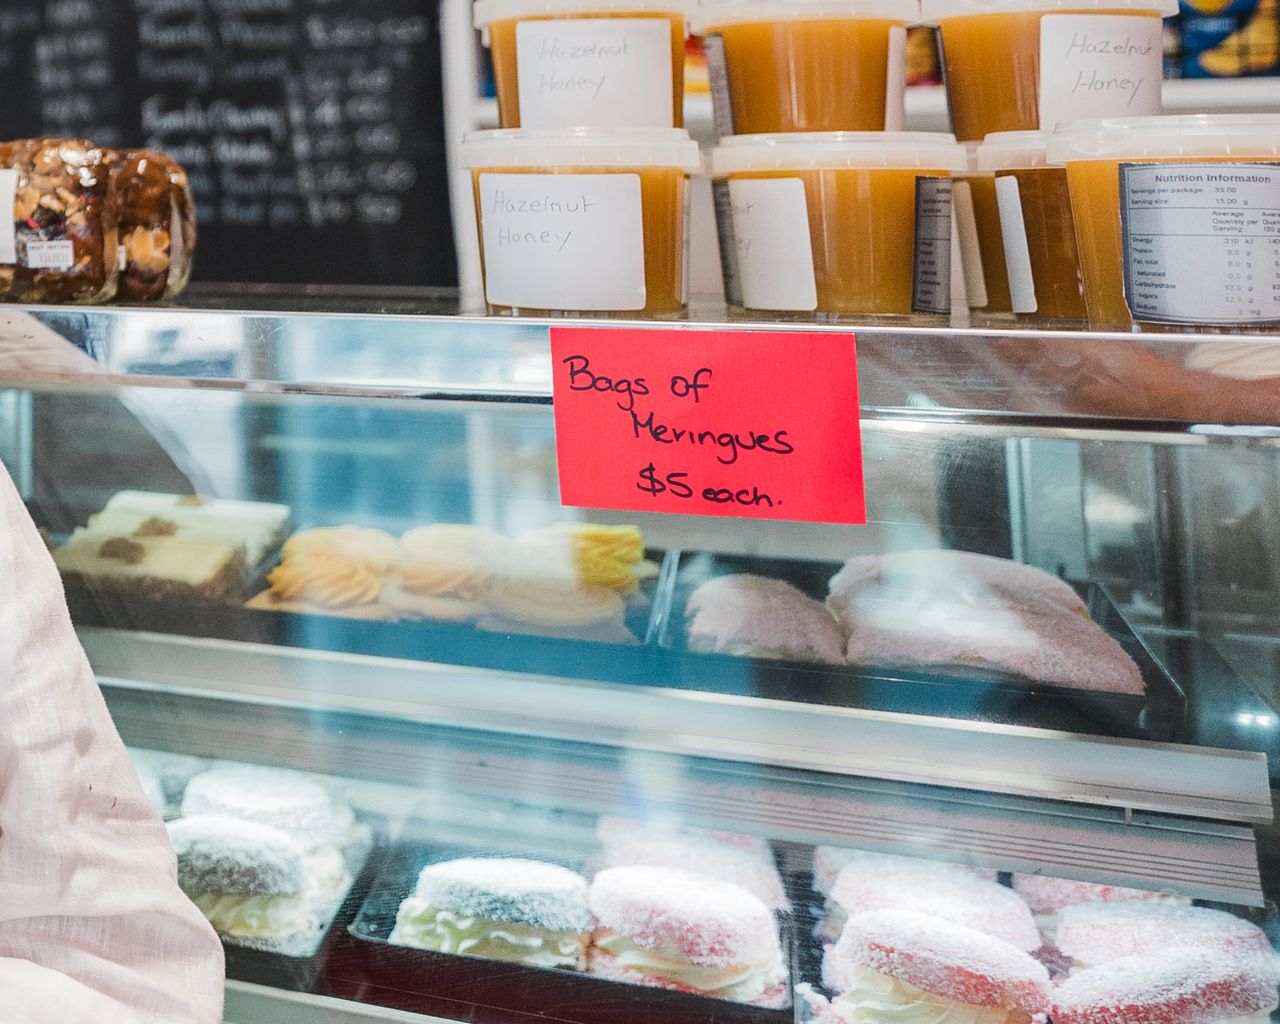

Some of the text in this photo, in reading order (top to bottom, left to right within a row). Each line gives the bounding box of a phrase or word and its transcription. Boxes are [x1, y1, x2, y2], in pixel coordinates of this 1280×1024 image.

[539, 37, 630, 60] Hazelnut
[539, 72, 606, 102] Honey
[1071, 69, 1143, 107] Honey
[1154, 174, 1271, 183] Nutrition Information
[493, 189, 596, 216] Hazelnut
[1212, 218, 1244, 226] Quantity
[1212, 225, 1243, 233] Serving
[498, 227, 573, 252] Honey
[563, 355, 712, 411] Bags of
[629, 409, 794, 464] Meringues
[636, 462, 782, 508] $5 each.
